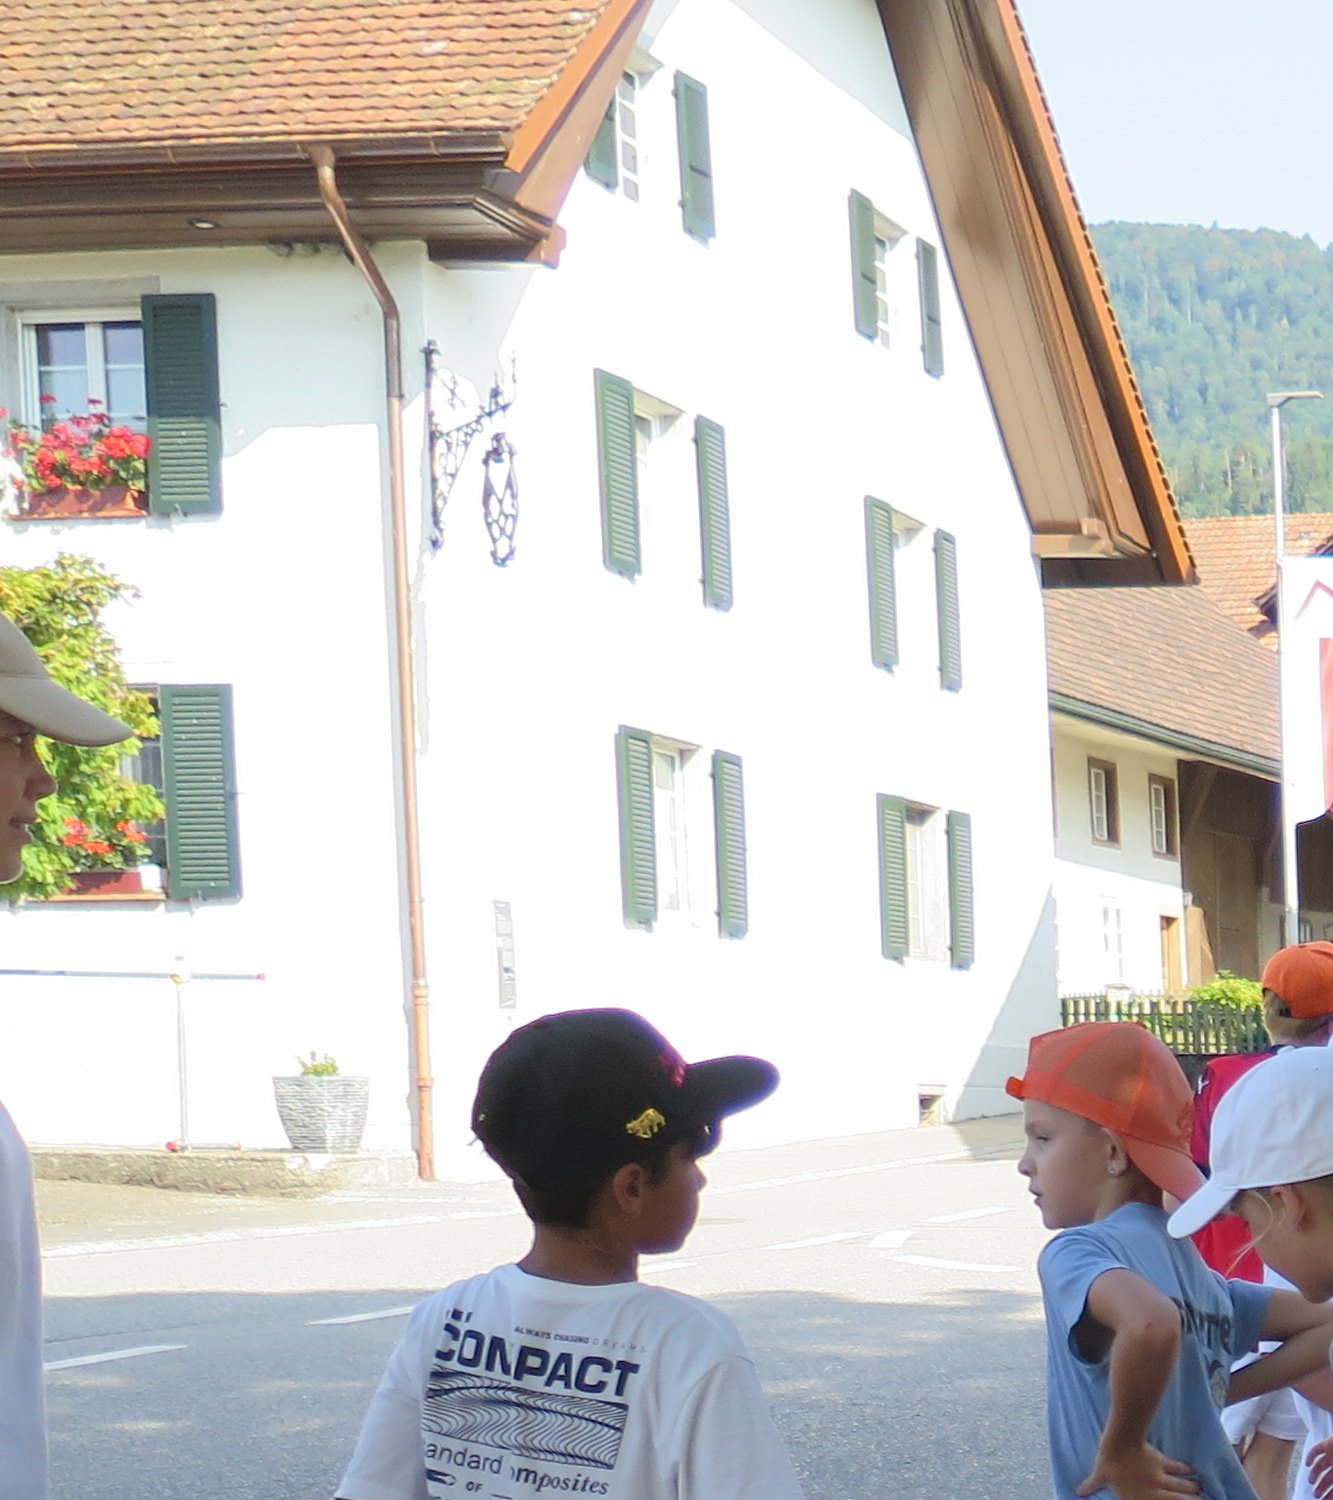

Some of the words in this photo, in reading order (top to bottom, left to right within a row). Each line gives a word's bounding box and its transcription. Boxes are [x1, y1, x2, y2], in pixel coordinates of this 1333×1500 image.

[514, 1326, 551, 1341] ALWAYS
[553, 1333, 590, 1345] CHASING
[423, 1441, 504, 1475] andard
[466, 1480, 484, 1493] OF
